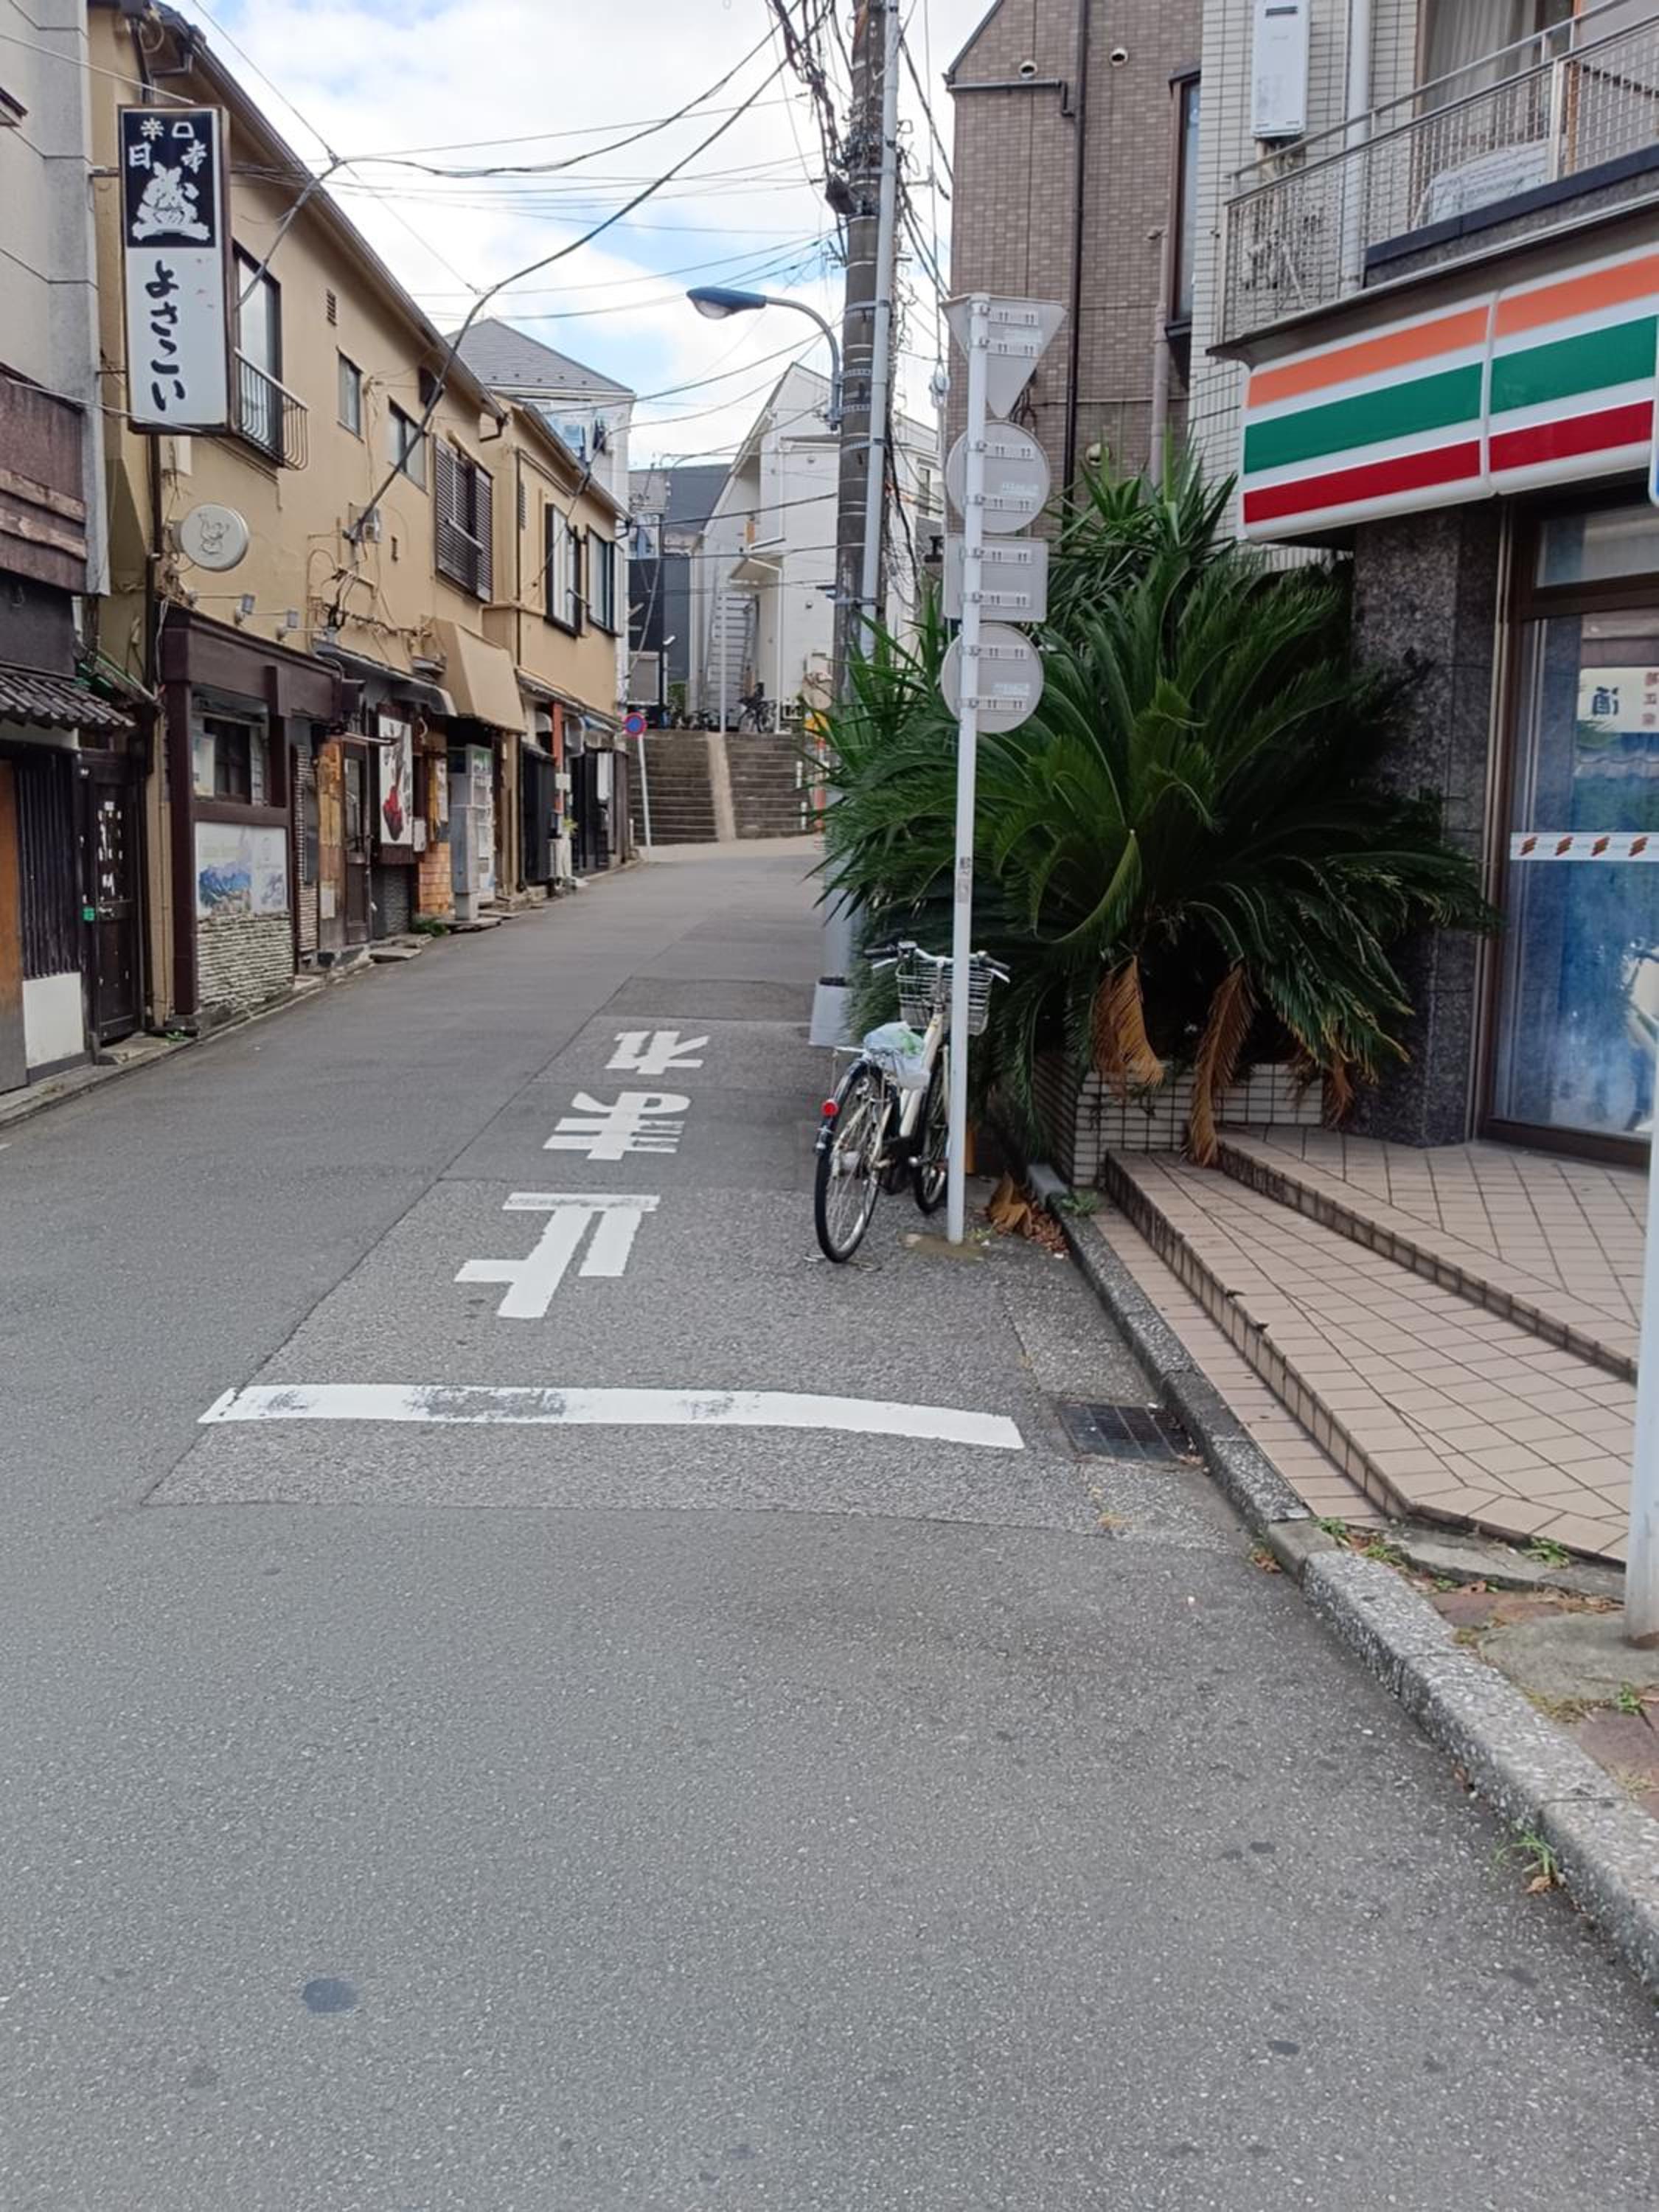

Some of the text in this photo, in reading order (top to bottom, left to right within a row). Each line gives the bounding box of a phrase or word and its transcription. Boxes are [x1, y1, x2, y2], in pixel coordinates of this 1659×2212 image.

[140, 117, 195, 141] 辛口
[145, 260, 186, 411] よさこい
[453, 1030, 710, 1319] 止まれ
